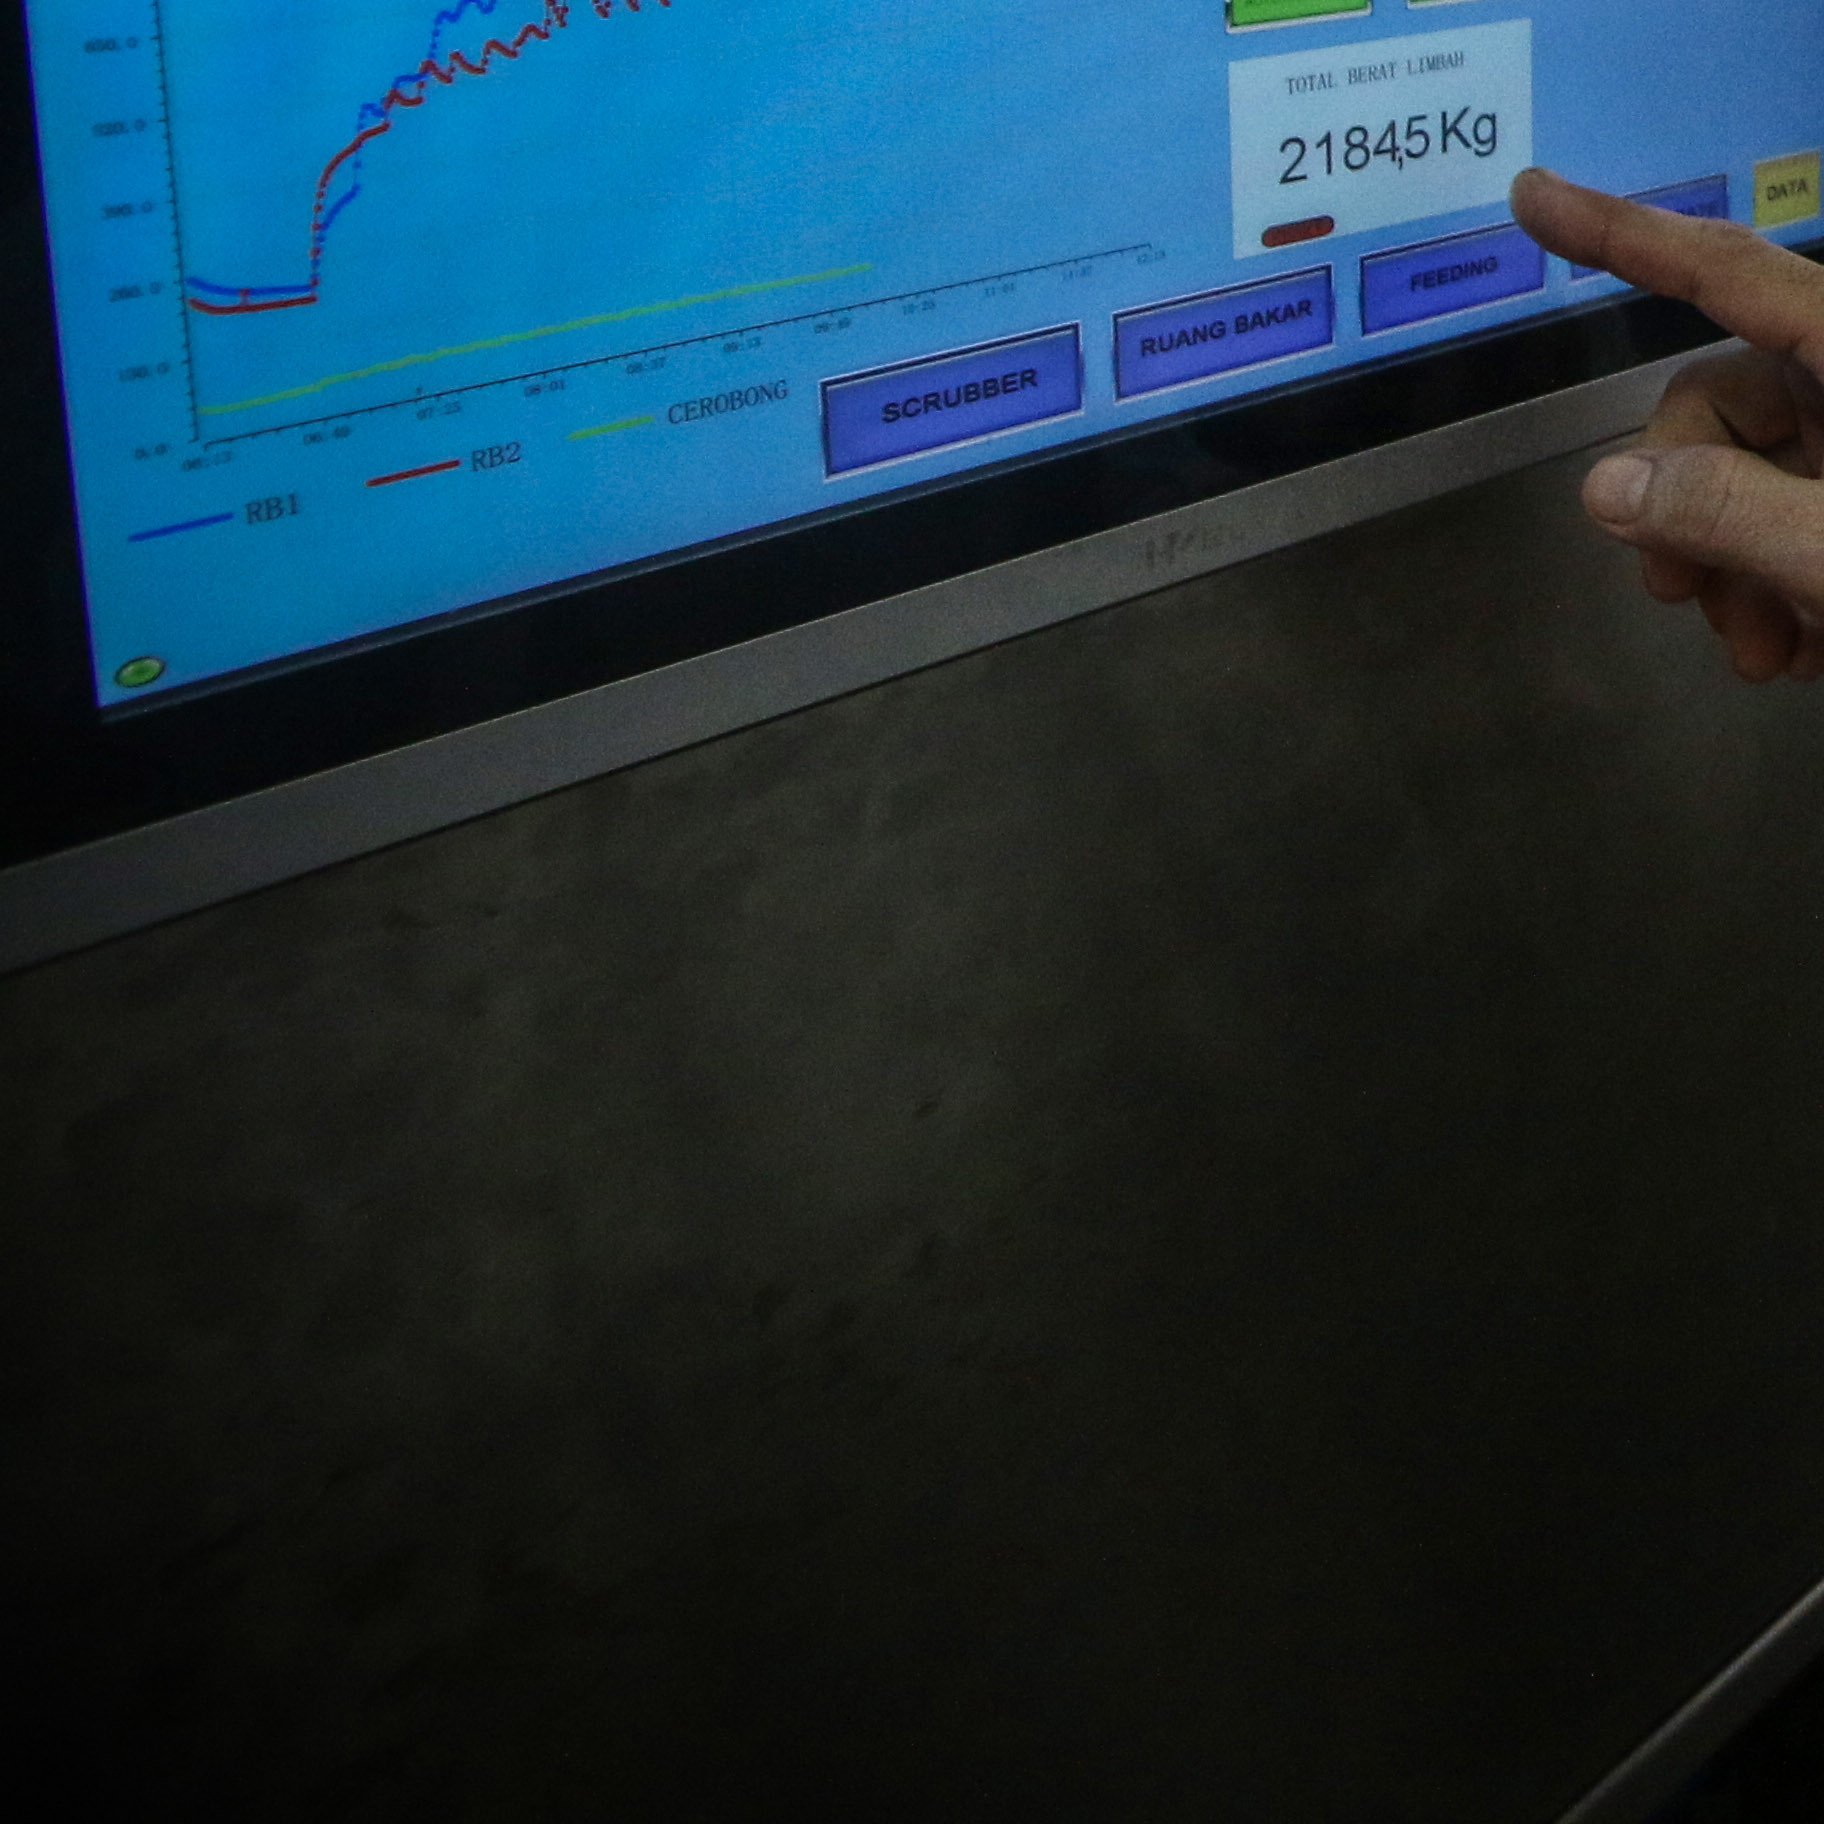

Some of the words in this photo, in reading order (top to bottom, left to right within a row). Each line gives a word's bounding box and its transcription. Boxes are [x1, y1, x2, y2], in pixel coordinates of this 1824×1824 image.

[1286, 72, 1335, 95] TOTAL
[1347, 60, 1398, 85] BERAT
[1406, 50, 1465, 75] LIMBAH
[1440, 105, 1498, 158] Kg
[1766, 178, 1809, 203] DATA
[1410, 255, 1498, 292] FEEDING
[1139, 319, 1227, 359] RUANG
[1234, 298, 1313, 340] BAKAR
[881, 366, 1038, 426] SCRUBBER
[244, 492, 299, 525] RB1
[469, 440, 523, 473] RB2
[666, 378, 790, 427] CEROBONG
